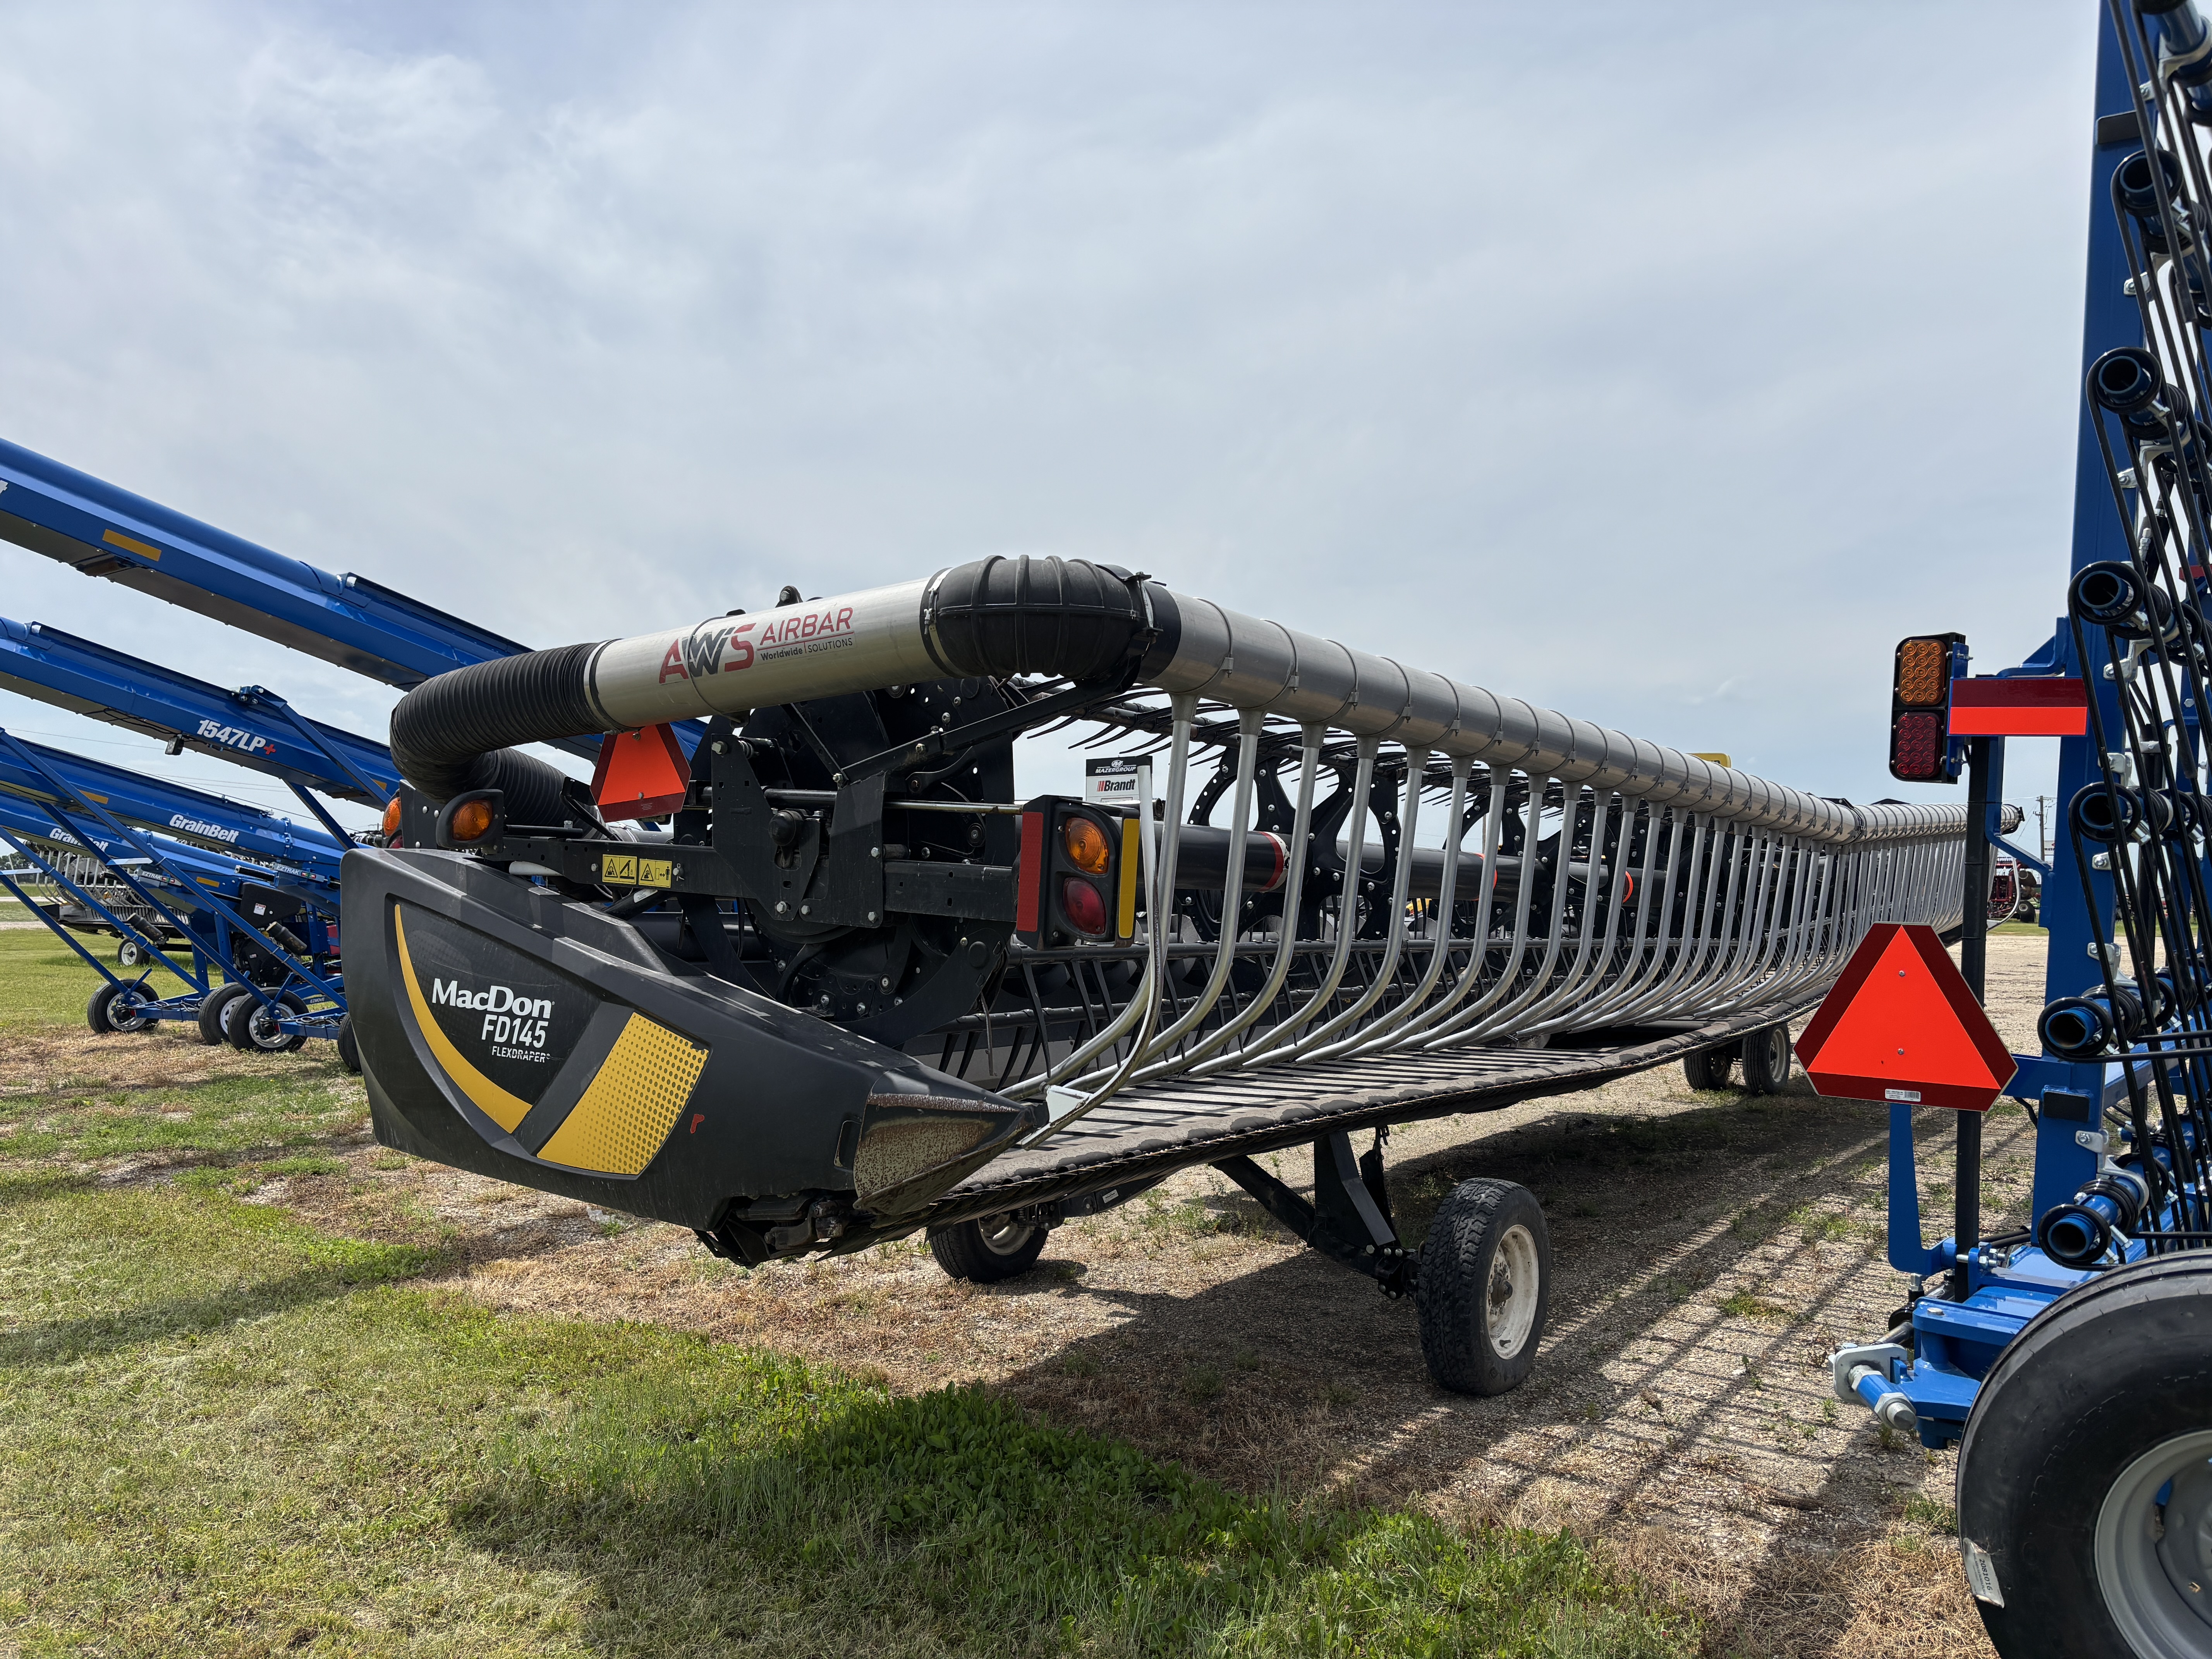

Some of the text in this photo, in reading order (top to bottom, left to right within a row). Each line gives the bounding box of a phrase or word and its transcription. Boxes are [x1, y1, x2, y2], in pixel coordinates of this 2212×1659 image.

[760, 607, 854, 646] AIRBAR
[659, 622, 757, 684] AWS
[760, 637, 853, 661] Worldwide SOLUTIONS
[1104, 779, 1136, 792] Brandt
[169, 814, 239, 843] GrainBelt
[142, 871, 161, 880] EZTRAK
[277, 865, 300, 875] EZTRAK
[481, 1014, 549, 1048] FD145
[1979, 1558, 1993, 1591] 2081016
